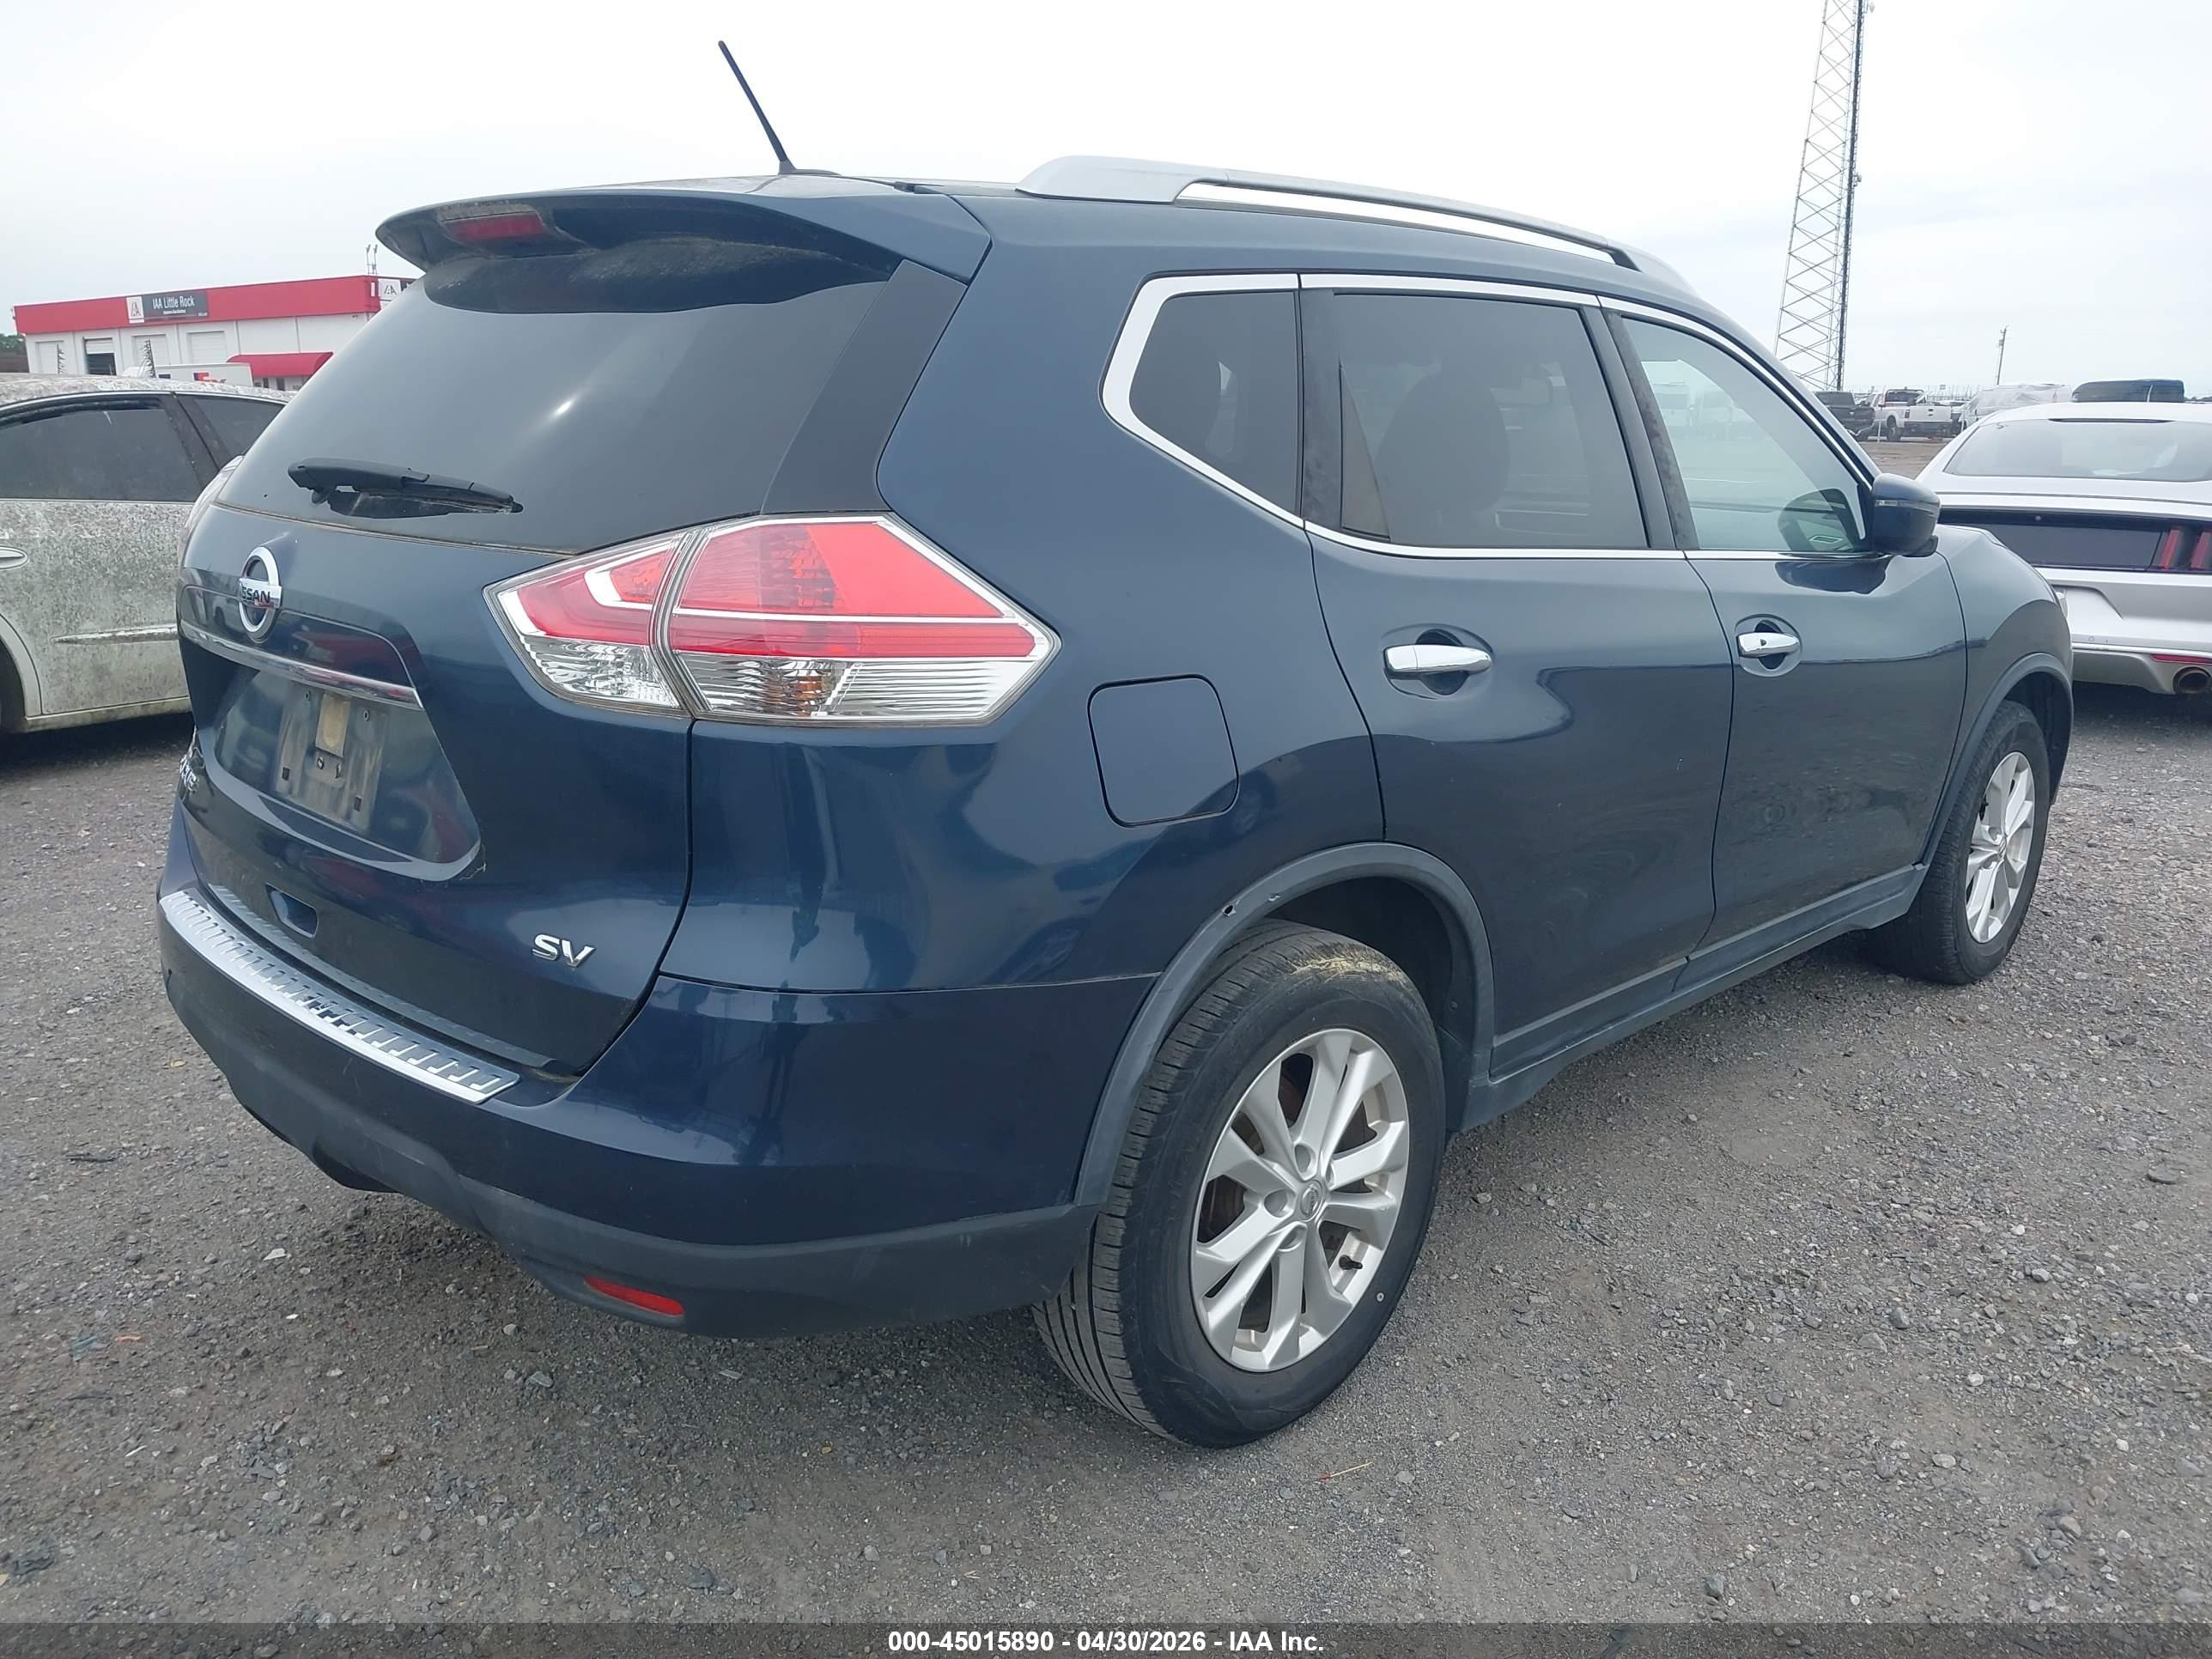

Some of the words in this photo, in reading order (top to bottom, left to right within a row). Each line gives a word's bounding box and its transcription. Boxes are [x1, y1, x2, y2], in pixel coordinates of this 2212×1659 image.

[163, 296, 179, 308] Little
[179, 295, 195, 307] Rock
[532, 934, 595, 968] SV
